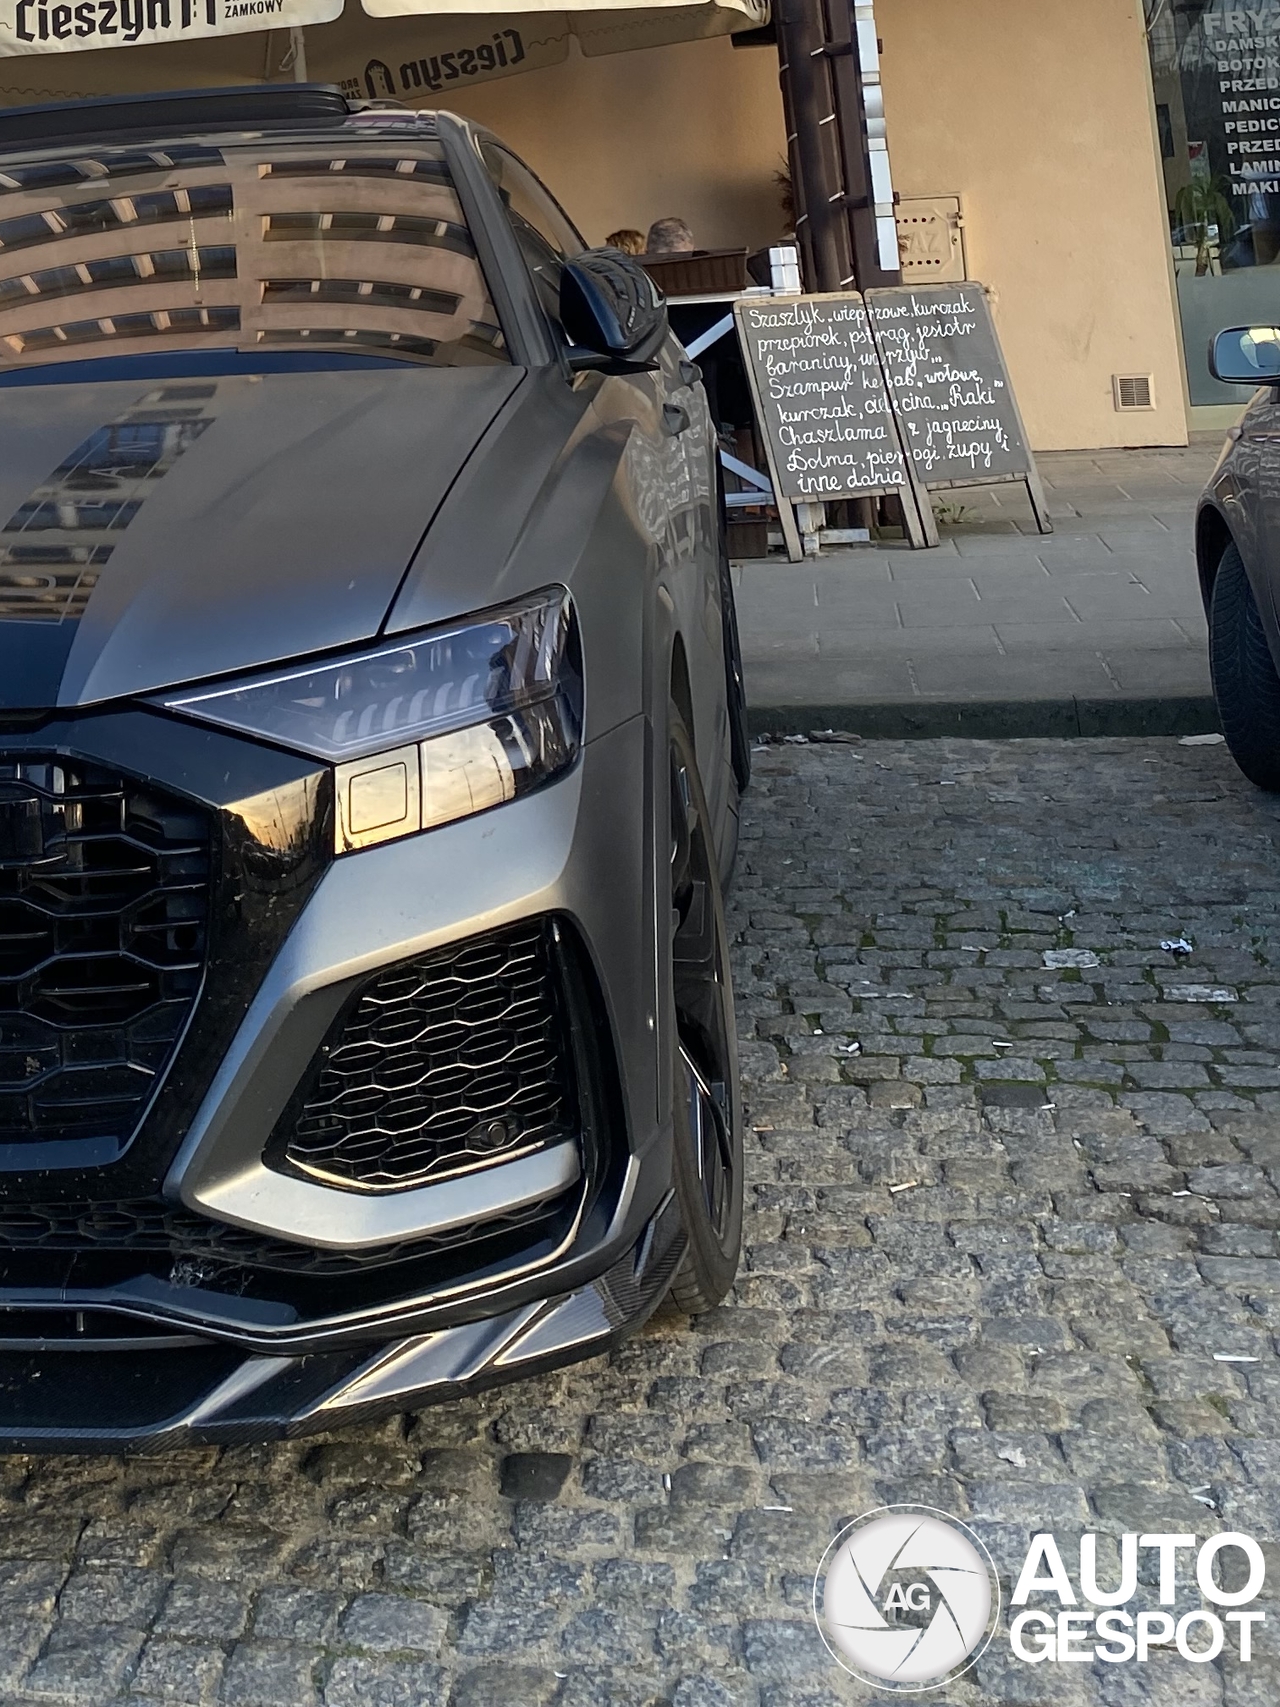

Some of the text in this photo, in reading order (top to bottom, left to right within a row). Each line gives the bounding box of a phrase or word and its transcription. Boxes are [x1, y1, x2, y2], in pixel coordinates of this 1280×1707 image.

[224, 0, 284, 19] ZAMKOWY
[770, 378, 854, 400] Szampur
[948, 441, 992, 469] zupy
[797, 468, 906, 494] inne dania
